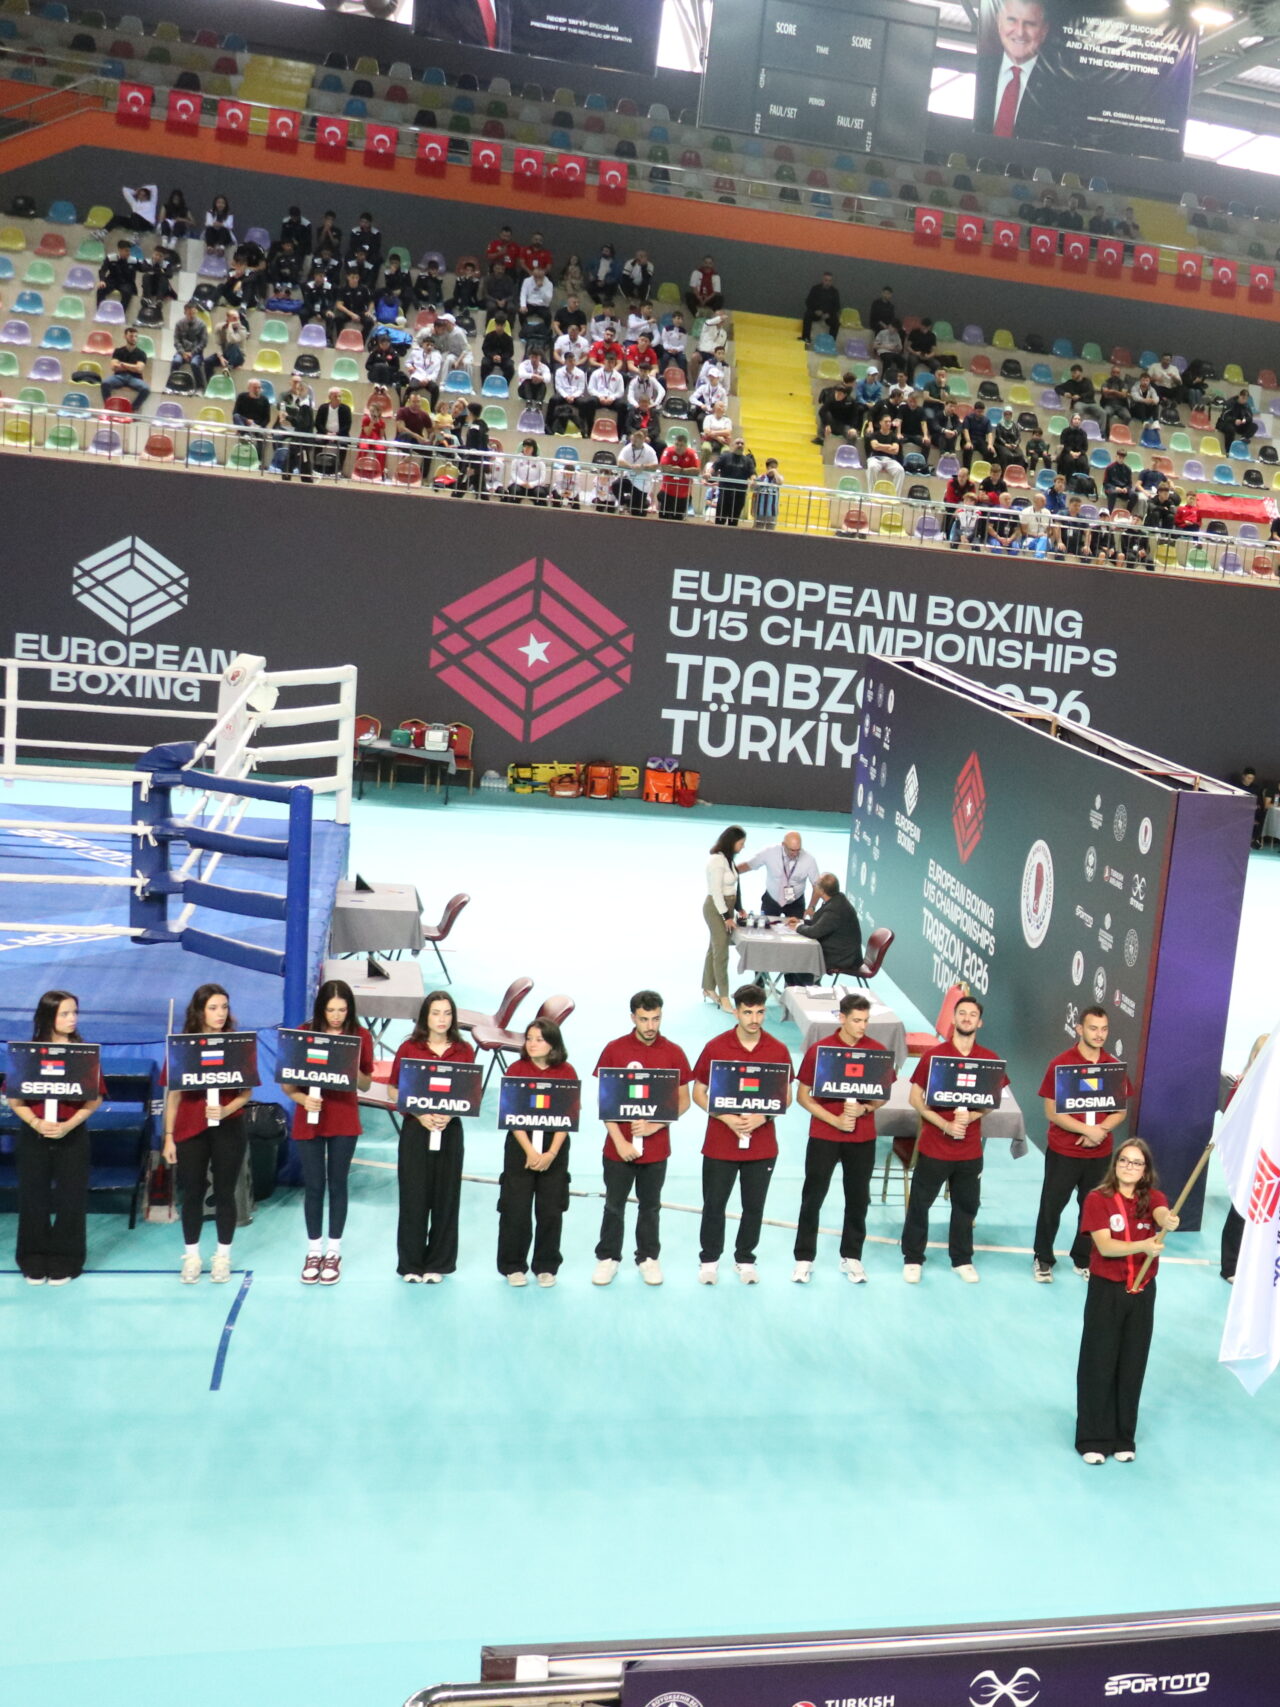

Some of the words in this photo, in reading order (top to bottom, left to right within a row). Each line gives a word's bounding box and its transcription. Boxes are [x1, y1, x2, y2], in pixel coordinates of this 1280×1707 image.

[776, 21, 797, 36] SCORE
[1063, 26, 1073, 35] TO
[1074, 27, 1088, 36] ALL
[816, 45, 829, 55] TIME
[851, 35, 872, 50] SCORE
[1066, 40, 1082, 50] AND
[1083, 44, 1121, 57] ATHLETES
[1080, 56, 1088, 64] IN
[1088, 58, 1103, 67] THE
[808, 97, 826, 107] PERIOD
[769, 103, 798, 119] FAUL/SET
[837, 115, 864, 130] FAUL/SET
[672, 568, 917, 624] EUROPEAN
[926, 595, 1084, 640] BOXING
[669, 605, 748, 642] U15
[760, 614, 1118, 678] CHAMPIONSHIPS
[15, 632, 237, 674] EUROPEAN
[50, 669, 200, 702] BOXING
[665, 652, 866, 715] TRABZ
[660, 702, 861, 769] TÜRKİY
[895, 810, 921, 843] EUROPEAN
[897, 830, 915, 855] BOXING
[928, 858, 967, 907] EUROPEAN
[966, 888, 995, 929] BOXING
[923, 878, 936, 904] U15
[935, 893, 995, 956] CHAMPIONSHIPS
[922, 906, 964, 972] TRABZON
[963, 949, 989, 996] 2026
[182, 1071, 243, 1085] RUSSIA
[282, 1067, 350, 1085] BULGARIA
[21, 1081, 83, 1095] SERBIA
[821, 1081, 884, 1096] ALBANIA
[406, 1096, 471, 1112] POLAND
[714, 1097, 781, 1111] BELARUS
[933, 1091, 995, 1105] GEORGIA
[1065, 1096, 1116, 1109] BOSNIA
[619, 1104, 658, 1117] ITALY
[505, 1113, 571, 1128] ROMANIA
[1104, 1672, 1210, 1696] SPORTOTO
[825, 1695, 895, 1707] TURKISH
